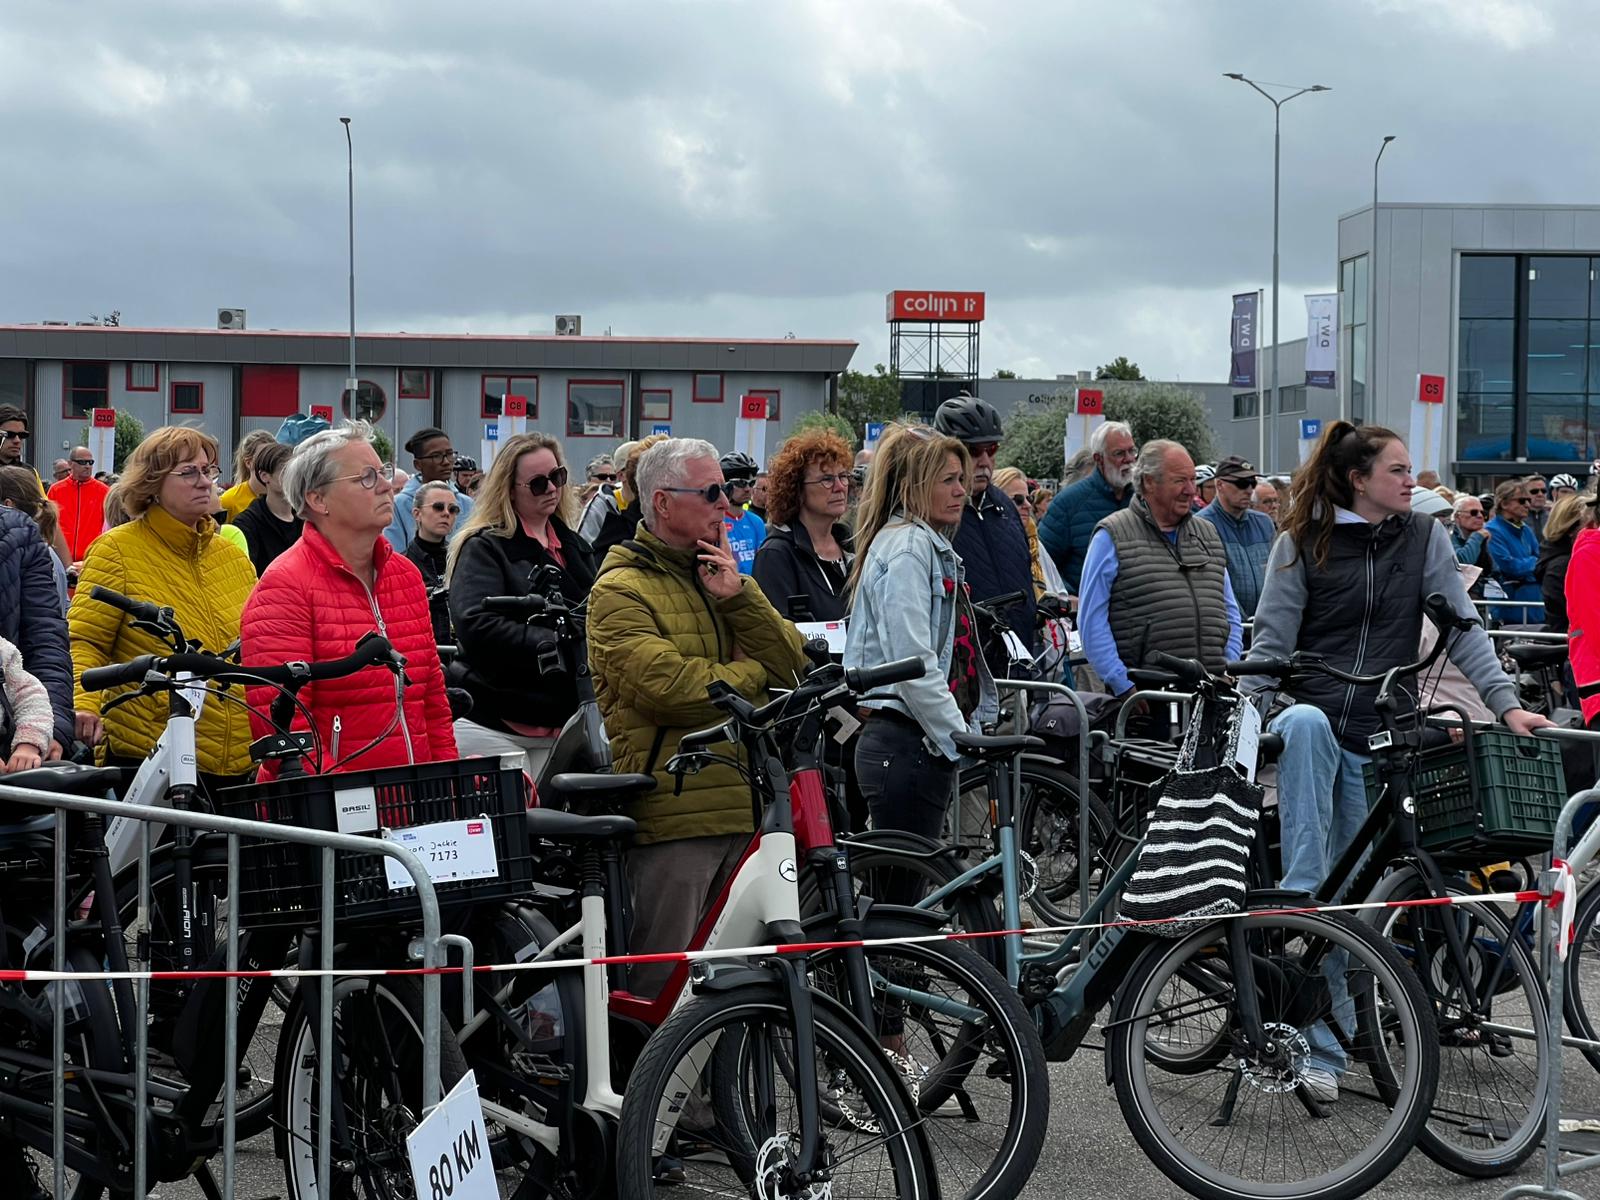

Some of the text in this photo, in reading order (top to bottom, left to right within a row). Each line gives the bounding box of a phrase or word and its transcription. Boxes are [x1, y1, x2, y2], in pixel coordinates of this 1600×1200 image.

[903, 293, 958, 317] colijn
[1425, 383, 1439, 395] C5
[510, 402, 522, 410] C8
[1082, 397, 1097, 407] C6
[747, 403, 761, 412] C7
[1307, 424, 1317, 433] B7
[342, 804, 370, 813] BASIL
[430, 840, 457, 850] Jackie
[429, 849, 458, 862] 7173
[236, 957, 260, 1016] AZELE
[429, 1119, 482, 1200] 80 KM
